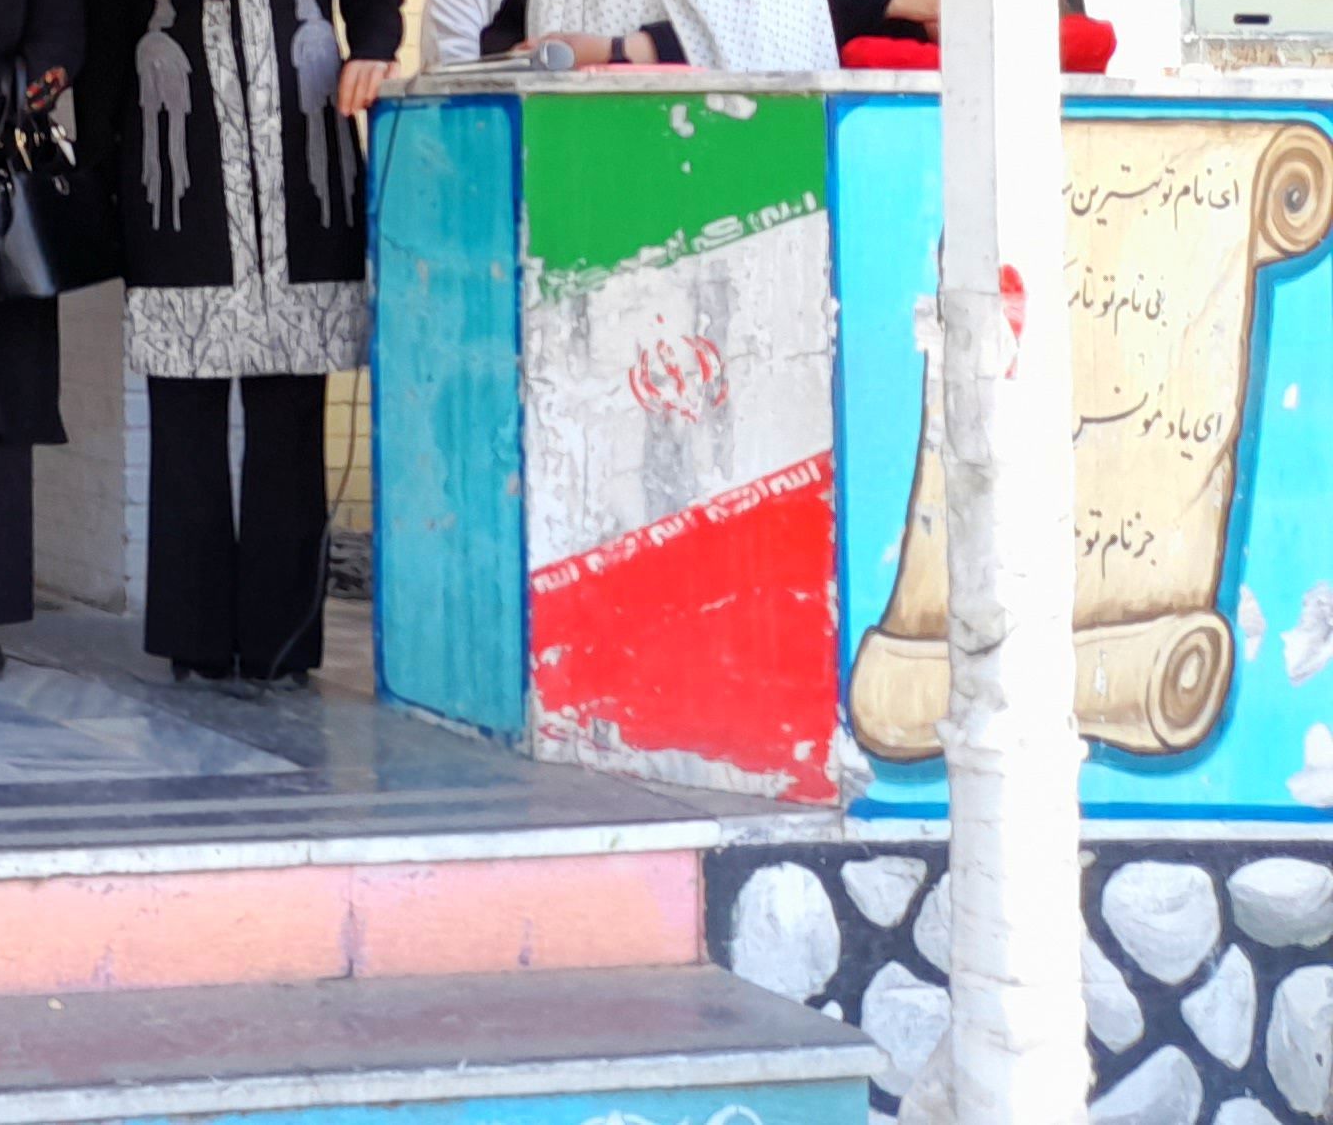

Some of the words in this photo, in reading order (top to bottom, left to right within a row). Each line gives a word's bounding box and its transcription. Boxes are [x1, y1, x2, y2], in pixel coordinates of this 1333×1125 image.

[1159, 166, 1176, 207] تو
[1174, 168, 1212, 230] نام
[1208, 179, 1239, 209] ای
[1094, 275, 1116, 318] تو
[1114, 273, 1145, 336] نام
[1145, 288, 1168, 327] بی
[1164, 407, 1193, 461] یاد
[1193, 412, 1222, 443] ای
[1082, 508, 1104, 557] تو
[1101, 517, 1133, 580] نام
[1133, 511, 1157, 567] جز
